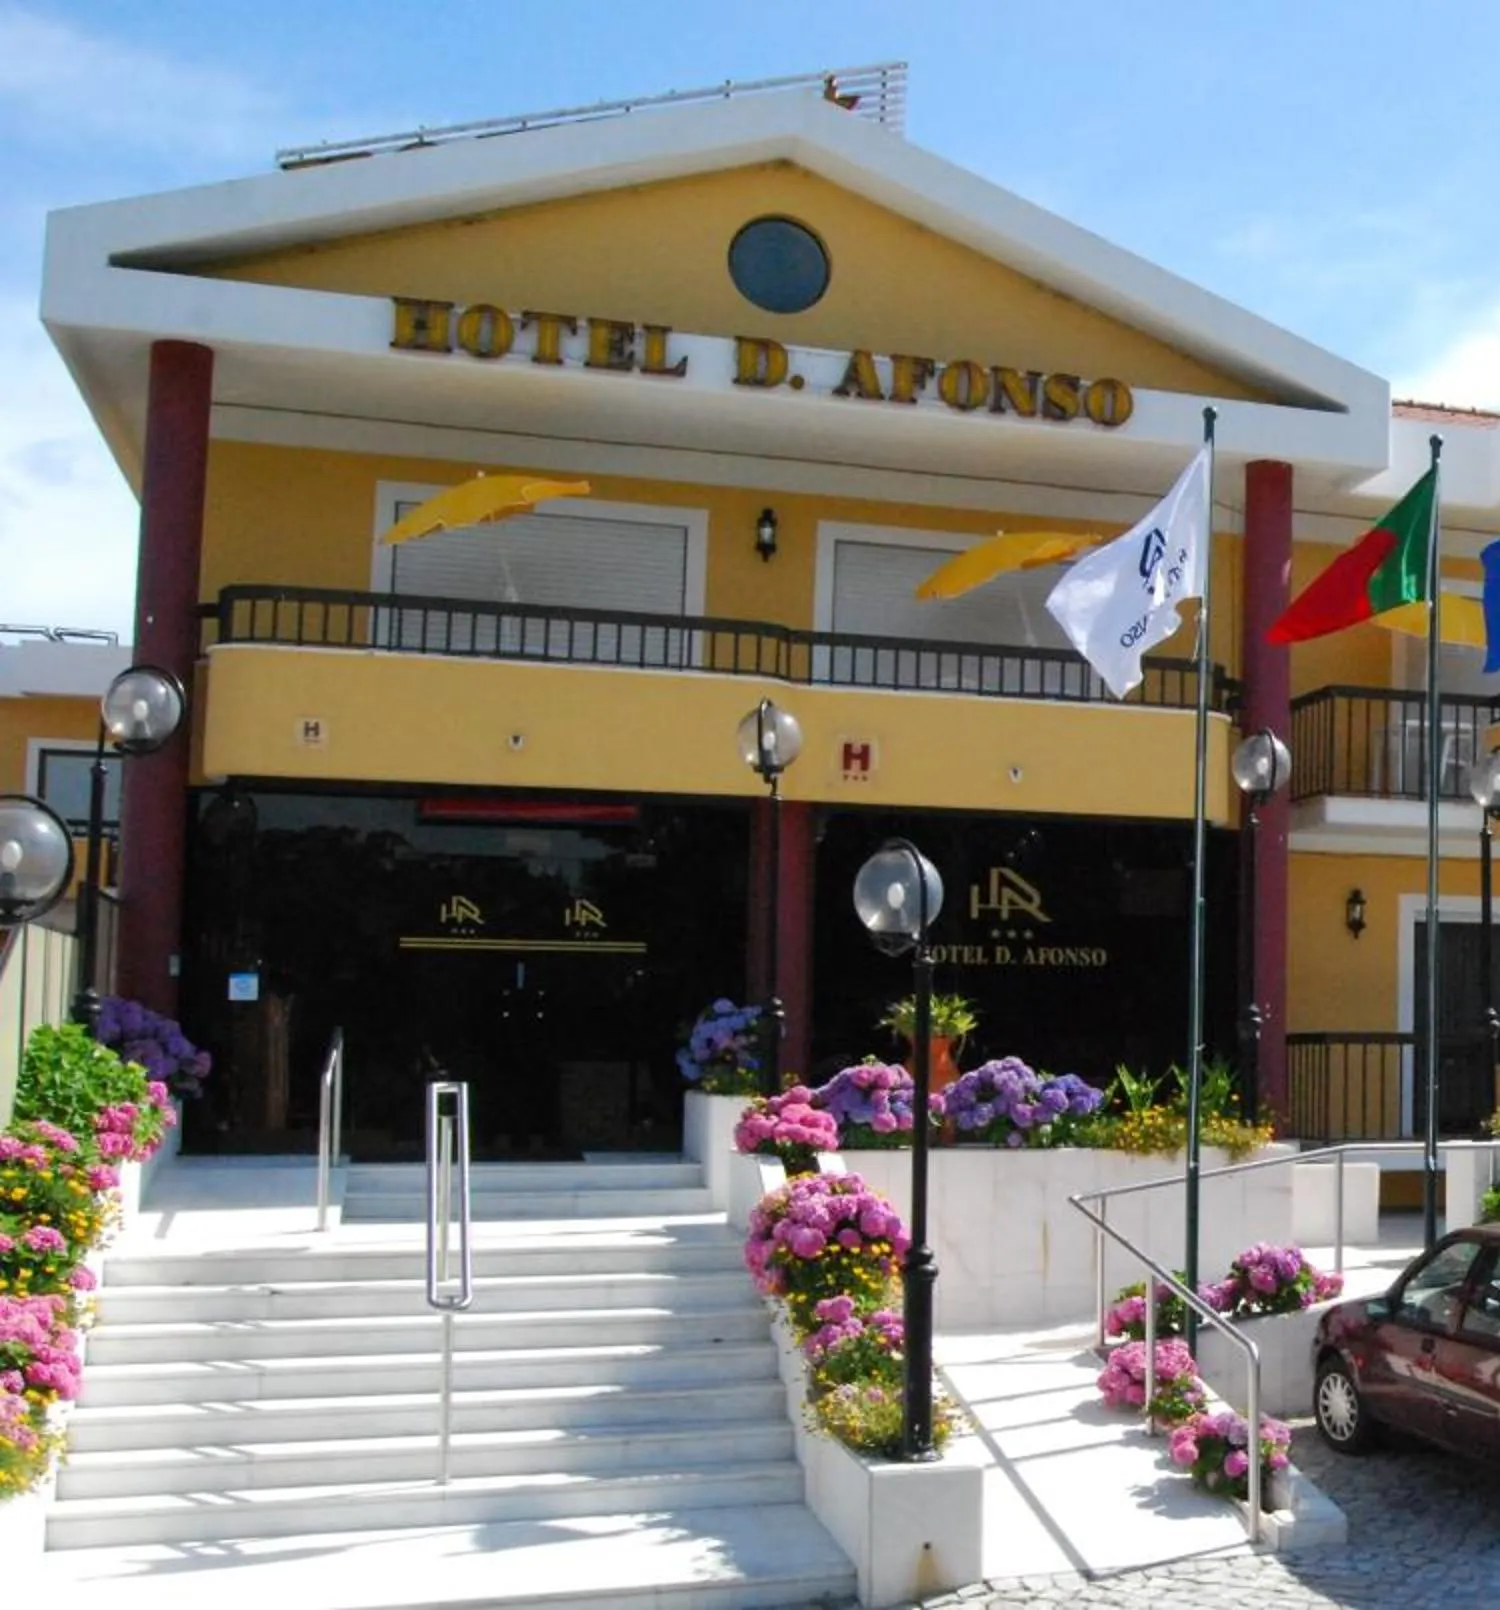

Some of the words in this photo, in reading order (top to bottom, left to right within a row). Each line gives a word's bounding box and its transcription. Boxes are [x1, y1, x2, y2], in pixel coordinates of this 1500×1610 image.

[389, 296, 689, 378] HOTEL
[732, 335, 805, 390] D.
[832, 349, 1133, 426] AFONSO
[303, 720, 320, 737] H
[842, 743, 870, 771] H
[917, 943, 990, 966] OTEL
[994, 945, 1017, 966] D.
[1023, 946, 1108, 967] AFONSO
